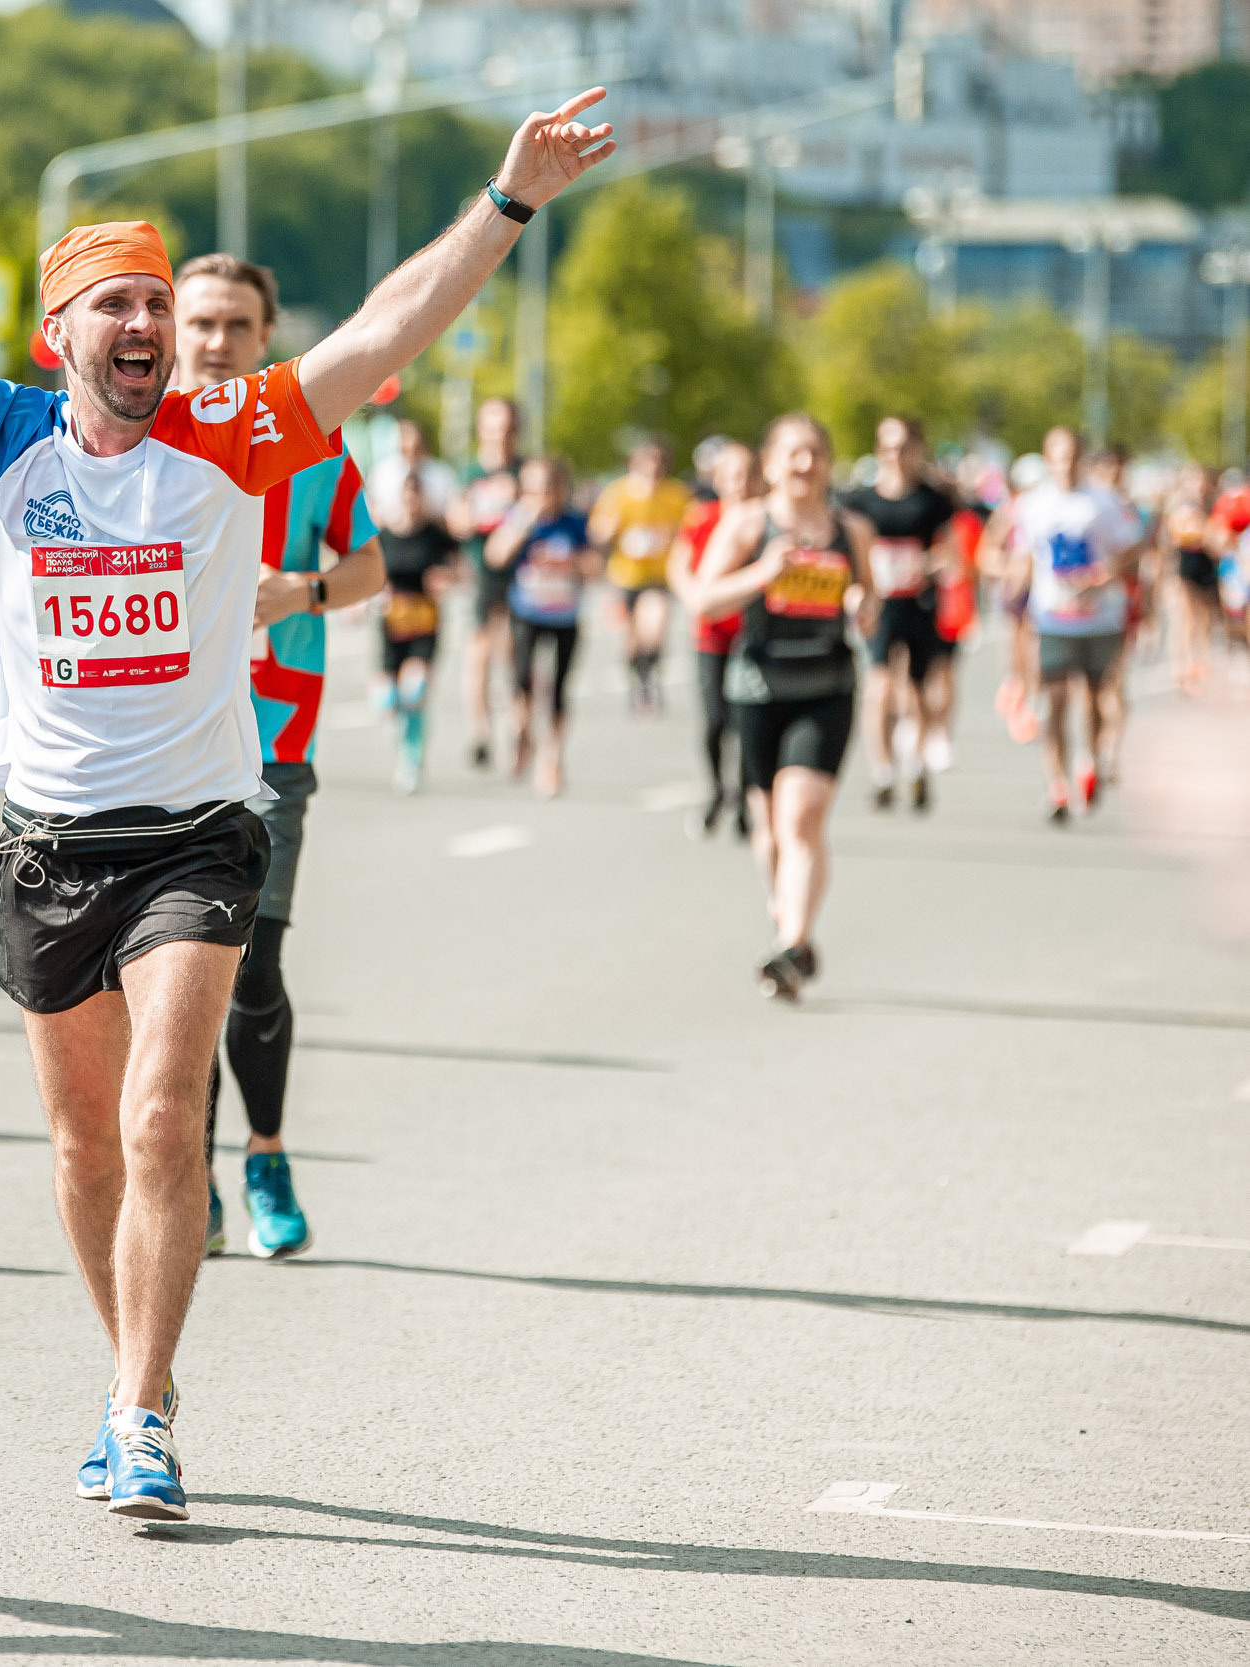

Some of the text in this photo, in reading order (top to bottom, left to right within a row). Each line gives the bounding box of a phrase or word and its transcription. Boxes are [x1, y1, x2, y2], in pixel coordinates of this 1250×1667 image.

[27, 498, 81, 529] ДИНАМО
[46, 549, 99, 559] МОСКОВСКИЙ
[44, 590, 179, 637] 15680
[56, 658, 73, 681] G
